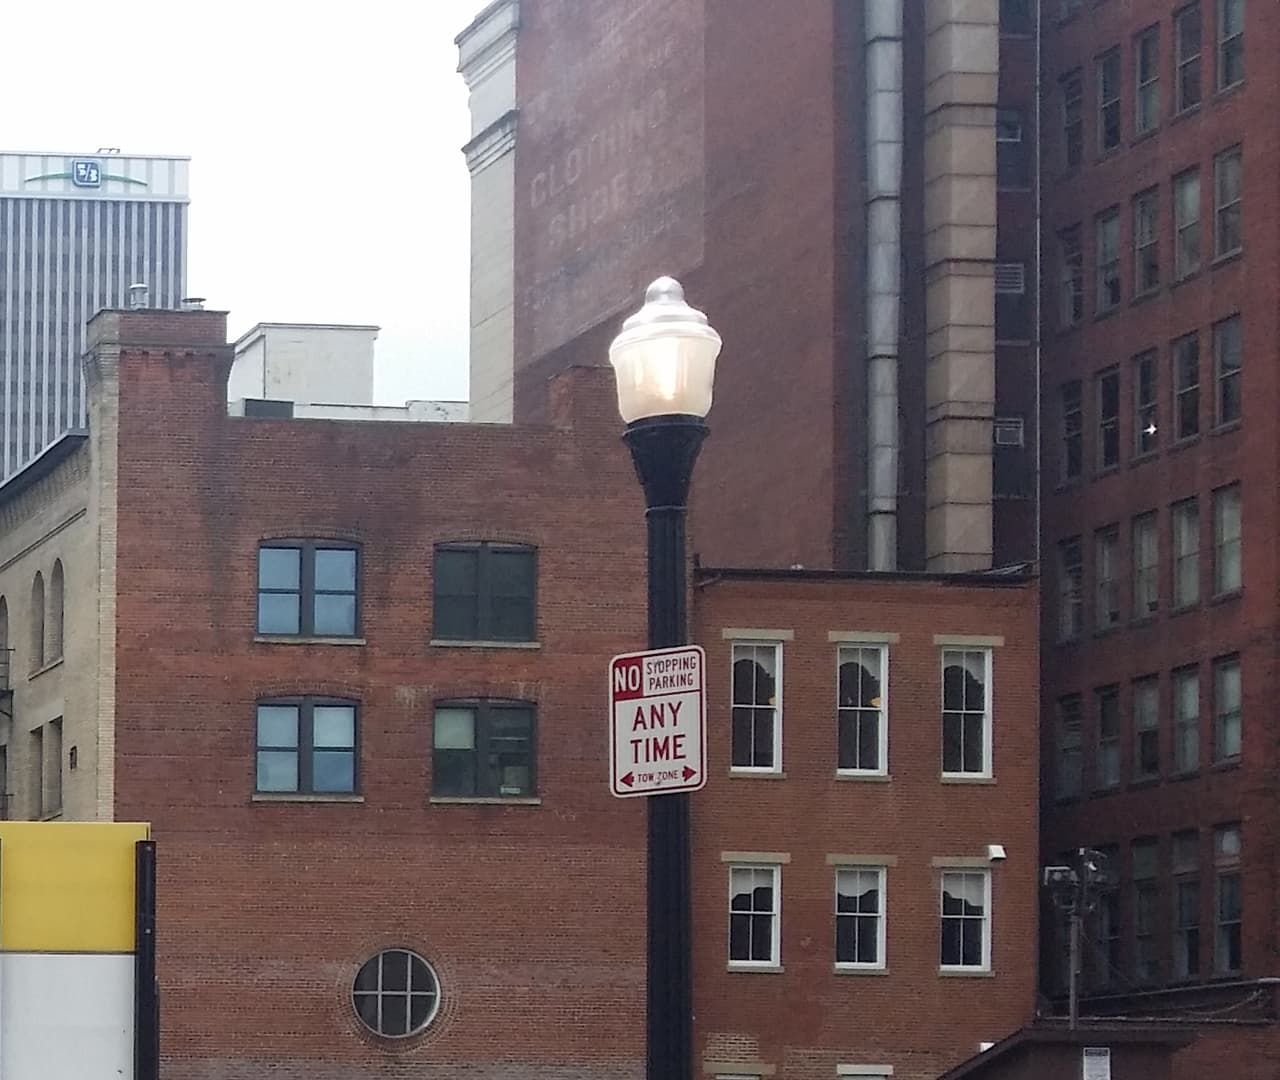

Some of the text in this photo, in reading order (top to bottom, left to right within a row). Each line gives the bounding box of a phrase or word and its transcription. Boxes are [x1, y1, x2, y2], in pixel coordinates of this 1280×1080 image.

[646, 656, 696, 675] STOPPING
[615, 666, 640, 693] NO
[649, 673, 694, 690] PARKING
[632, 701, 683, 731] ANY
[630, 734, 686, 764] TIME
[638, 770, 679, 783] TOW ZONE
